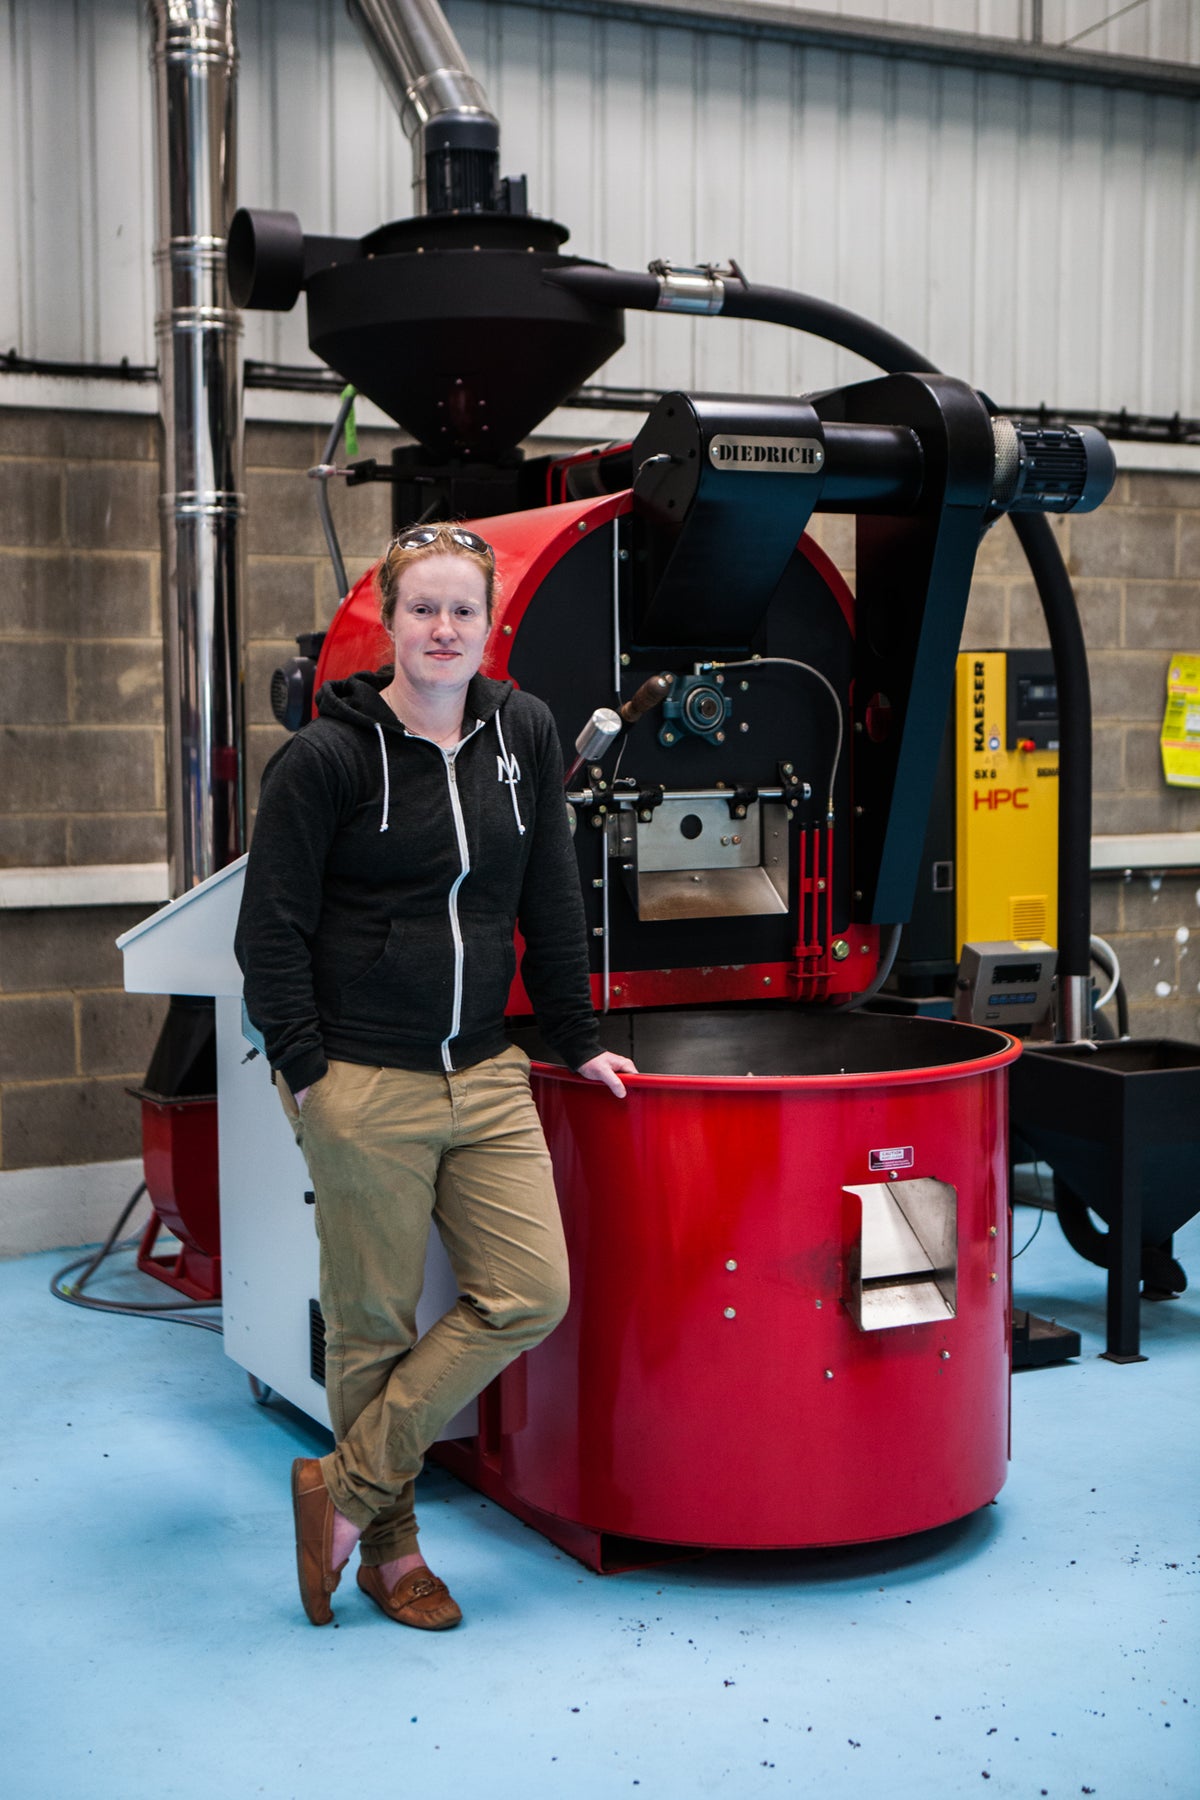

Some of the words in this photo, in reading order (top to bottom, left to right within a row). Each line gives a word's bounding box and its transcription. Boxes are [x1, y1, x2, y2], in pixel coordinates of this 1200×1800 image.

[719, 445, 814, 464] DIEDRICH
[974, 661, 985, 751] KAESER
[974, 769, 987, 779] SX
[974, 787, 1029, 811] HPC
